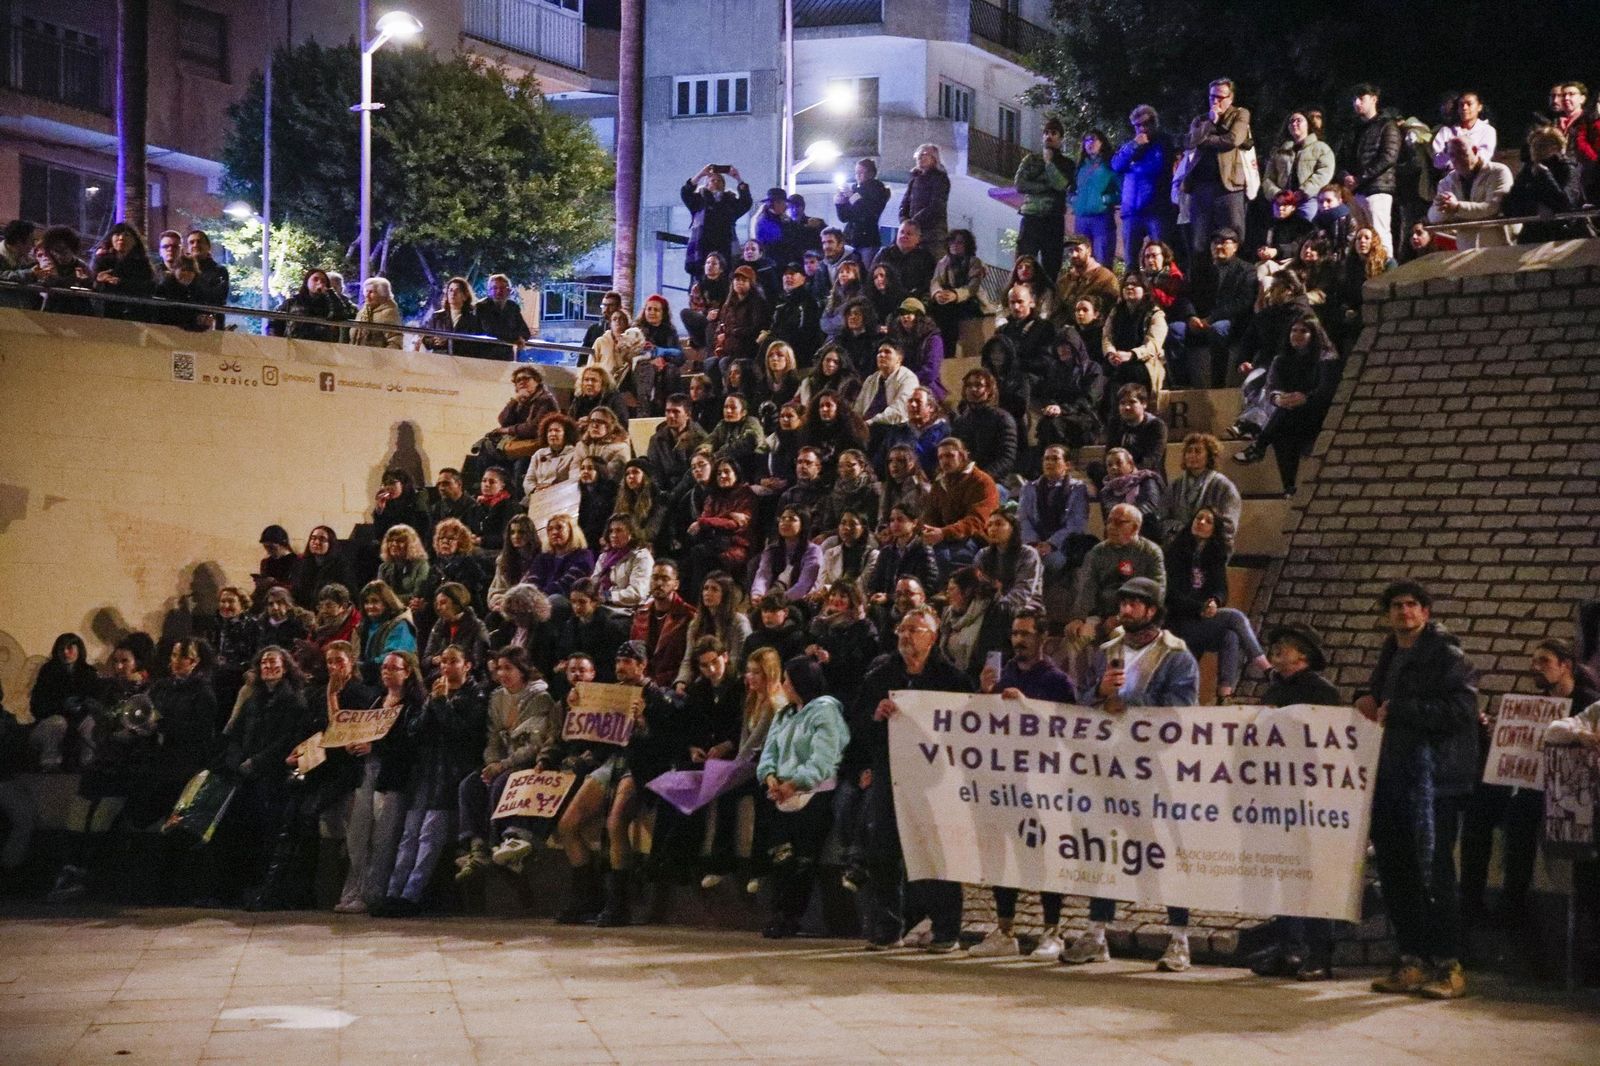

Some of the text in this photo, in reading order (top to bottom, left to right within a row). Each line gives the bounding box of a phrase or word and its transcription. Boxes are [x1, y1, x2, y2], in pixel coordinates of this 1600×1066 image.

[203, 374, 258, 387] moxaico
[932, 708, 1359, 750] HOMBRES CONTRA LAS
[918, 742, 1368, 791] VIOLENCIAS MACHISTAS
[510, 774, 563, 789] DEJEMOS
[505, 789, 518, 801] DE
[959, 781, 1350, 833] el silencio nos hace cómplices
[1058, 828, 1166, 876] ahige
[1239, 850, 1253, 864] de
[1260, 864, 1274, 877] de
